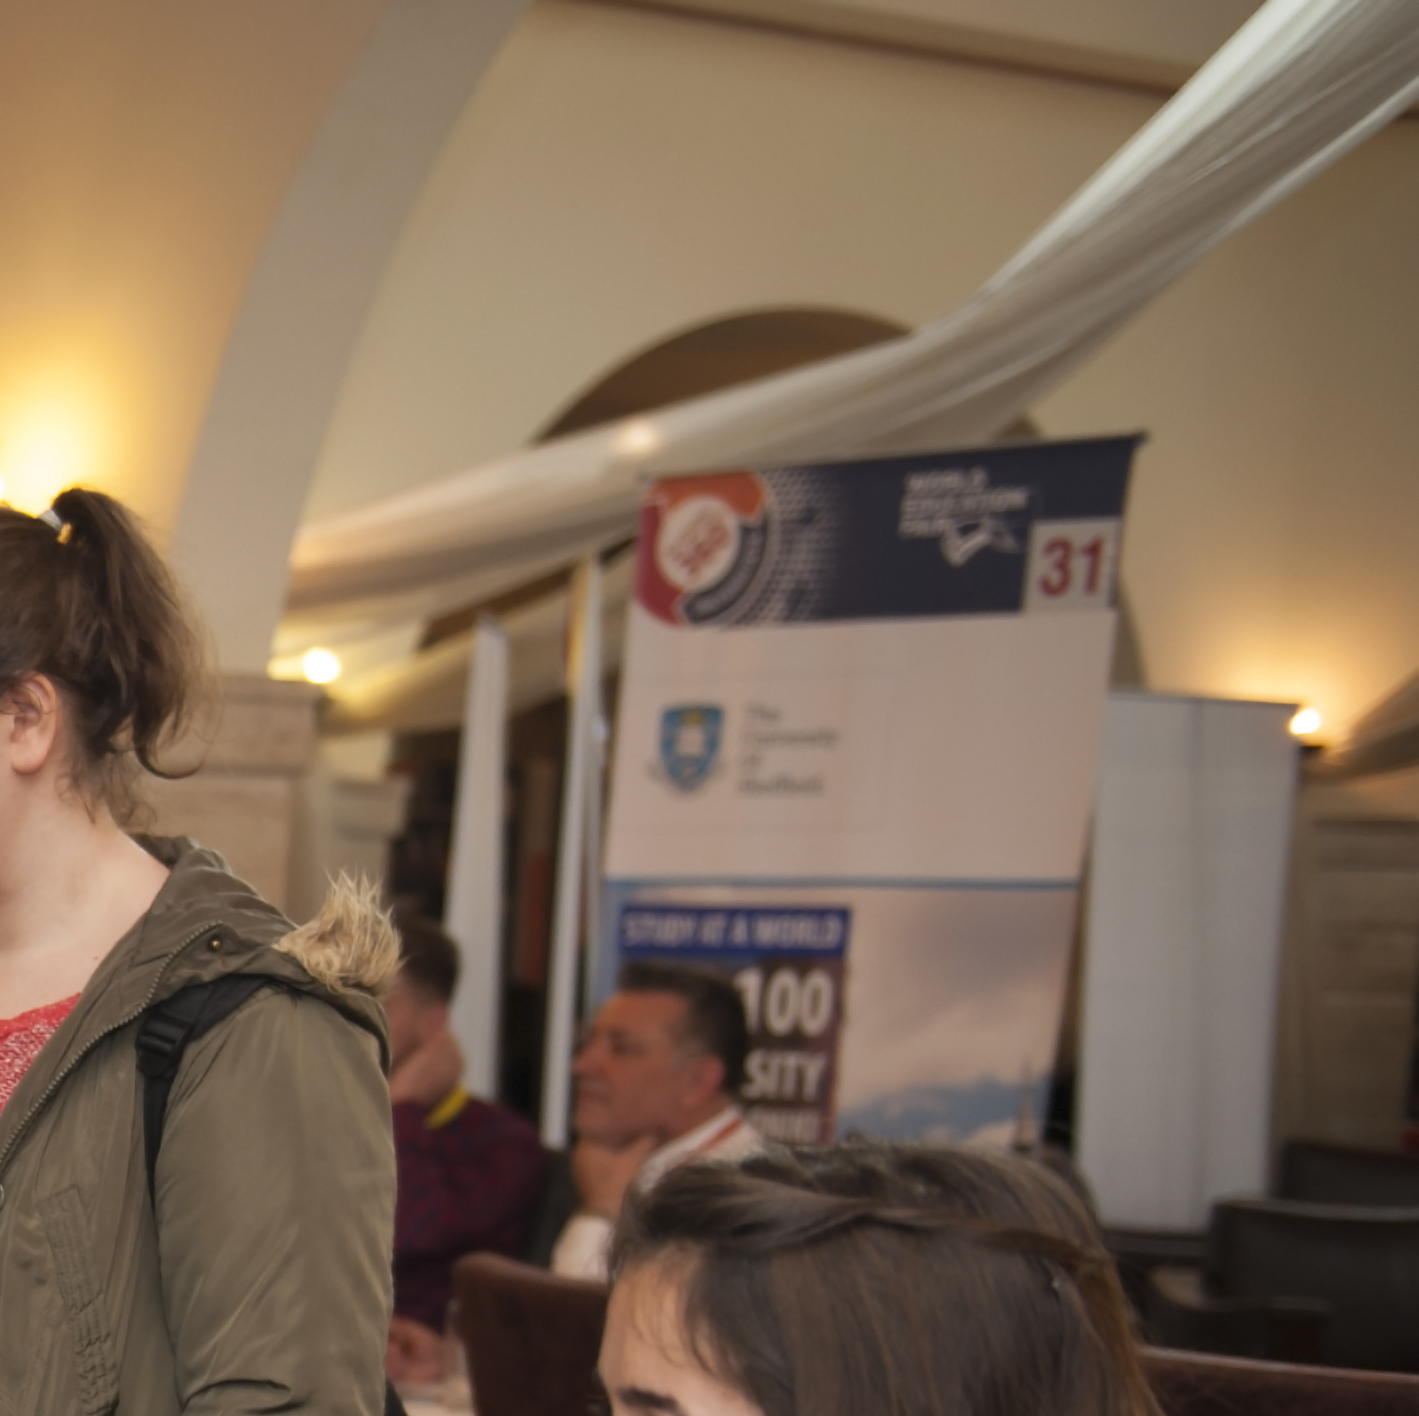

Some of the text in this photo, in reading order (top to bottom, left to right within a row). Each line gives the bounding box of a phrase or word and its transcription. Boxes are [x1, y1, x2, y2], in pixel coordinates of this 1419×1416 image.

[1039, 534, 1105, 598] 31
[624, 912, 842, 947] STUDY AT A WORLD
[733, 966, 834, 1037] 100
